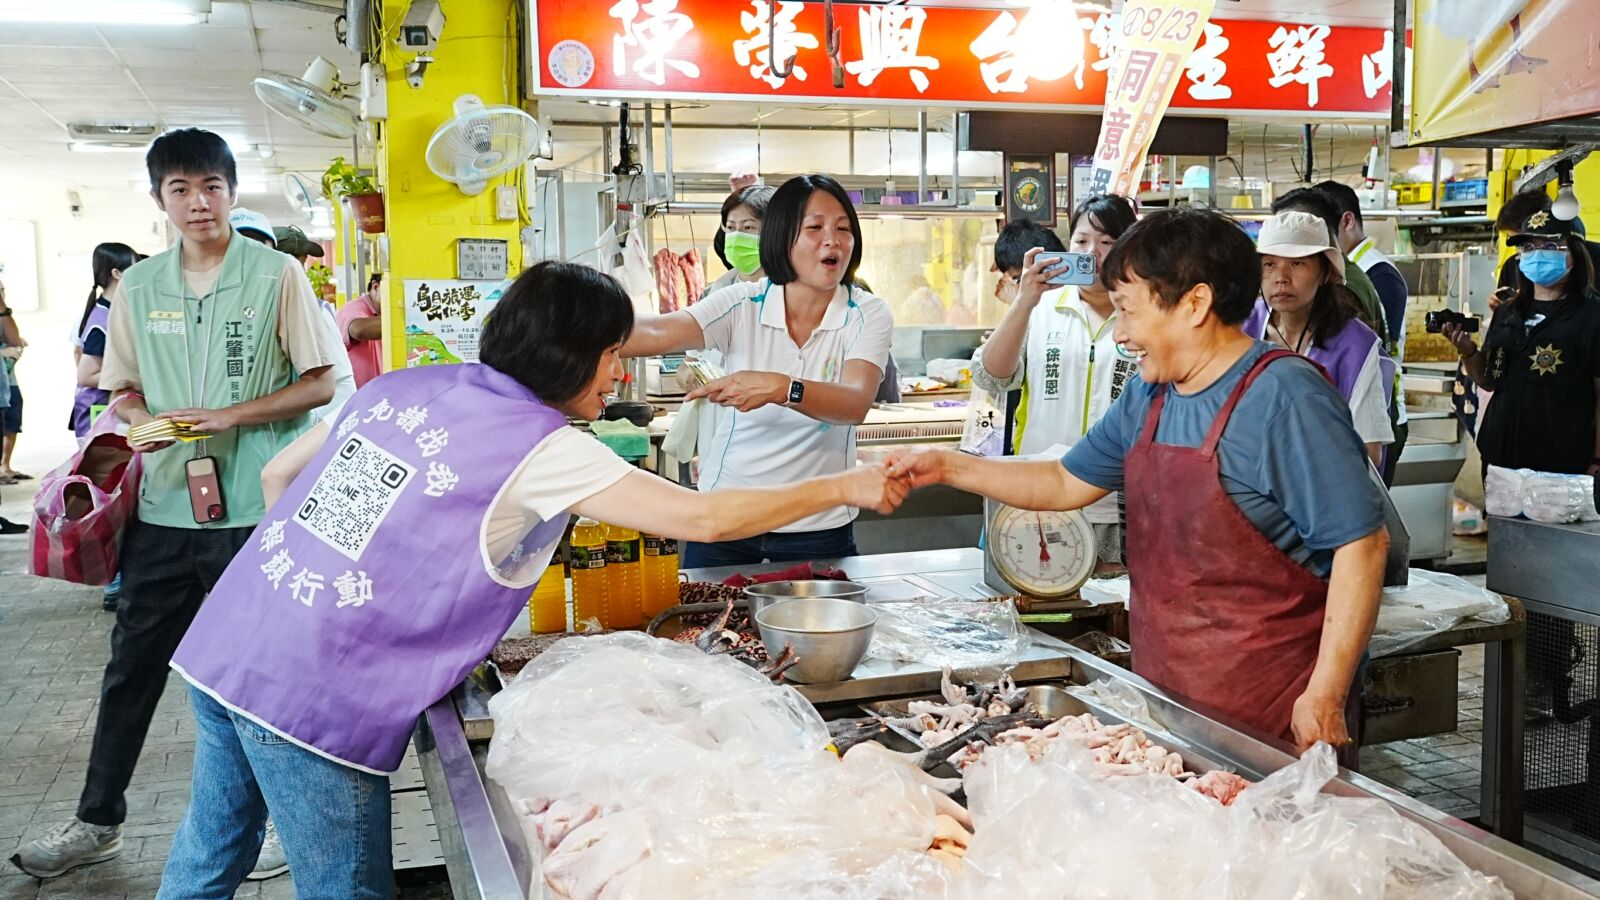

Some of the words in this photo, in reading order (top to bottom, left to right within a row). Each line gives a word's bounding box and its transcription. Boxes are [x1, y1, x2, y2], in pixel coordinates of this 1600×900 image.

[427, 302, 476, 321] 文化季
[225, 321, 244, 377] 江肇國
[1044, 347, 1060, 395] 徐筑恩
[230, 381, 240, 404] 服務
[336, 398, 460, 497] 罷免請找我
[337, 481, 360, 501] LINE
